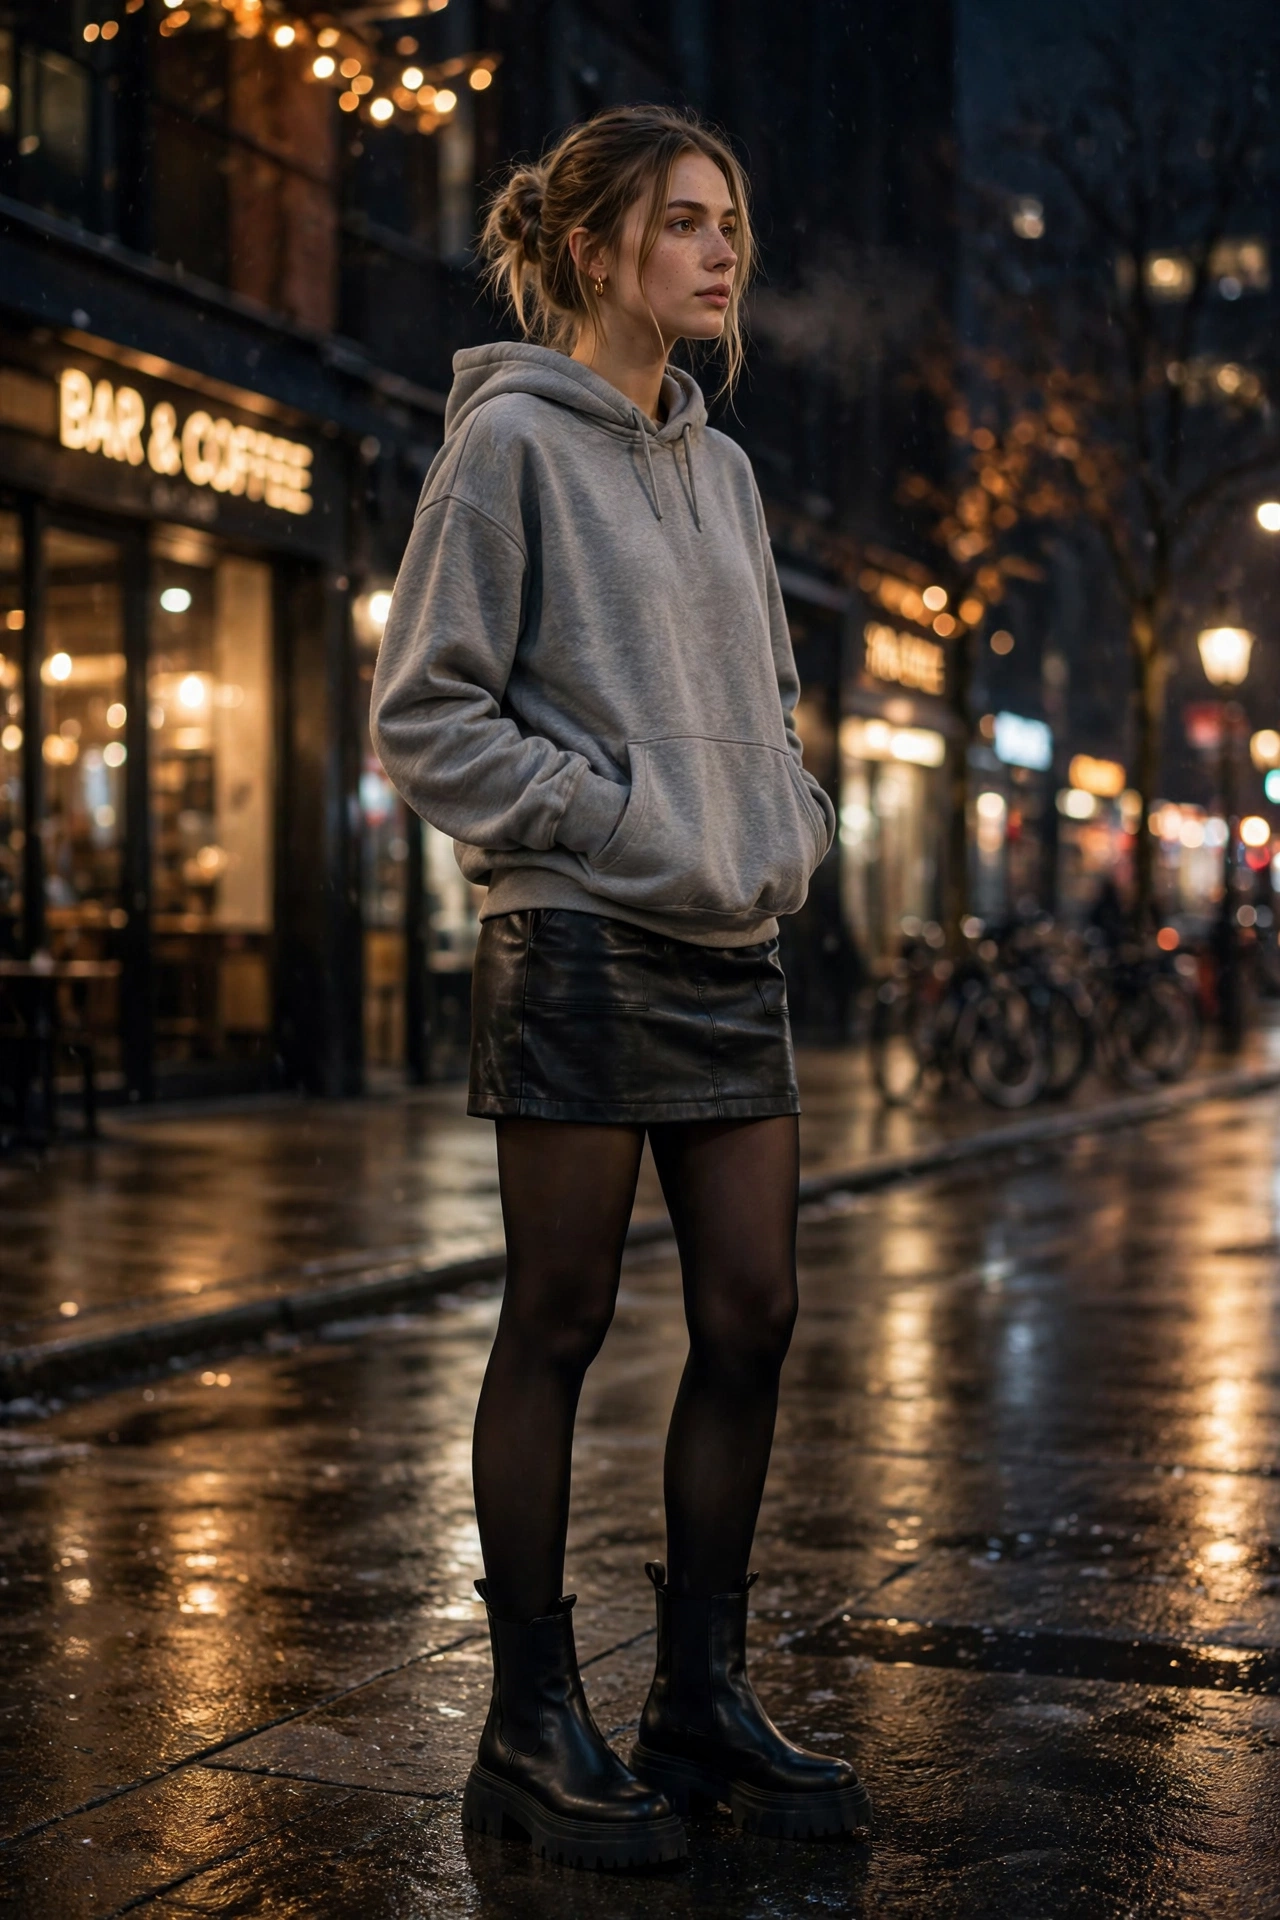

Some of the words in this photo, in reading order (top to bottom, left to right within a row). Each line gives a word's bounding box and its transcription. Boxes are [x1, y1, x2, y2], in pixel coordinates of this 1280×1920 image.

[61, 368, 145, 465] BAR
[148, 402, 181, 475] &
[182, 411, 313, 514] COFFEE
